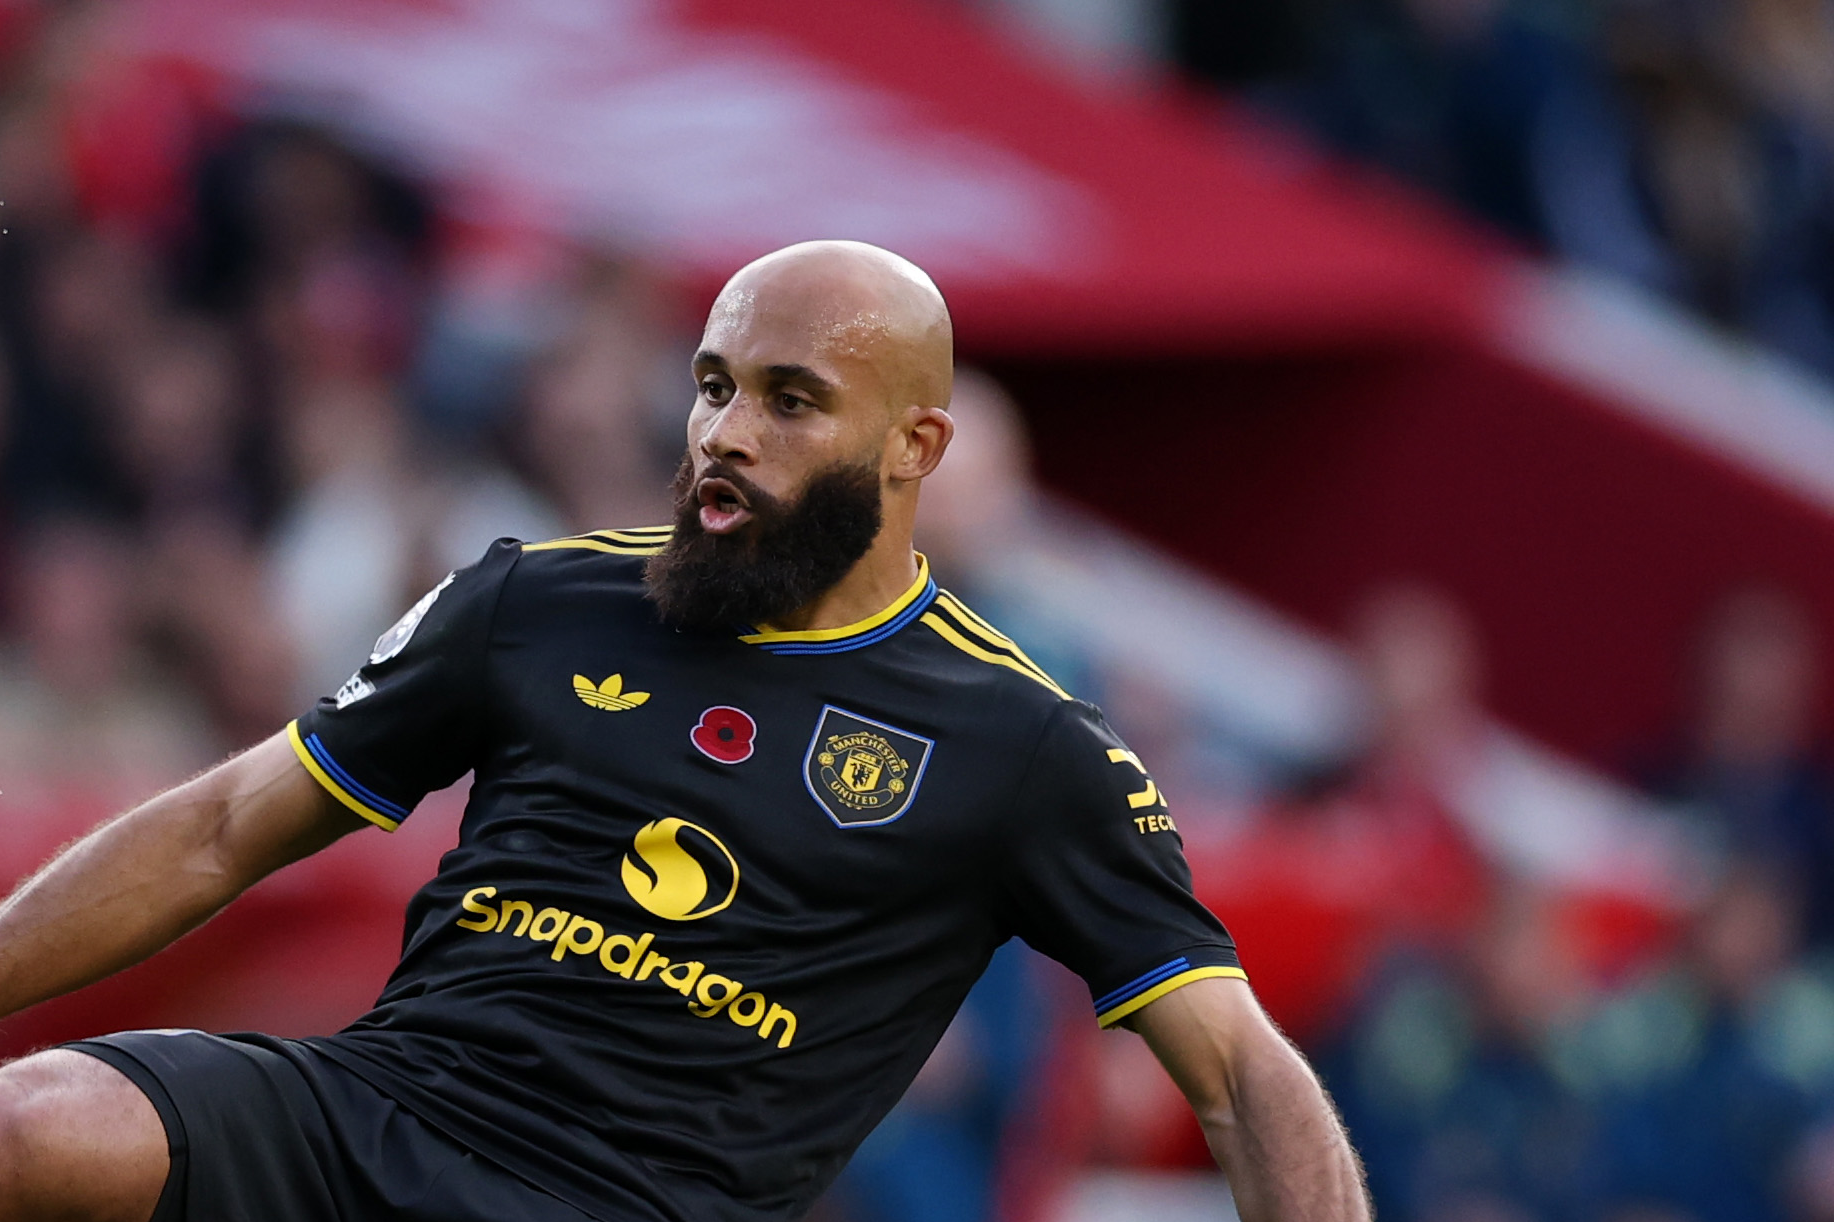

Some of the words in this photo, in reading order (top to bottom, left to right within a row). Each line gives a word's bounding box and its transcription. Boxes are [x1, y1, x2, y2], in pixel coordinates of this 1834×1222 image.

[832, 736, 901, 773] MANCHESTER
[830, 780, 878, 804] UNITED
[455, 886, 797, 1048] Snapdragon
